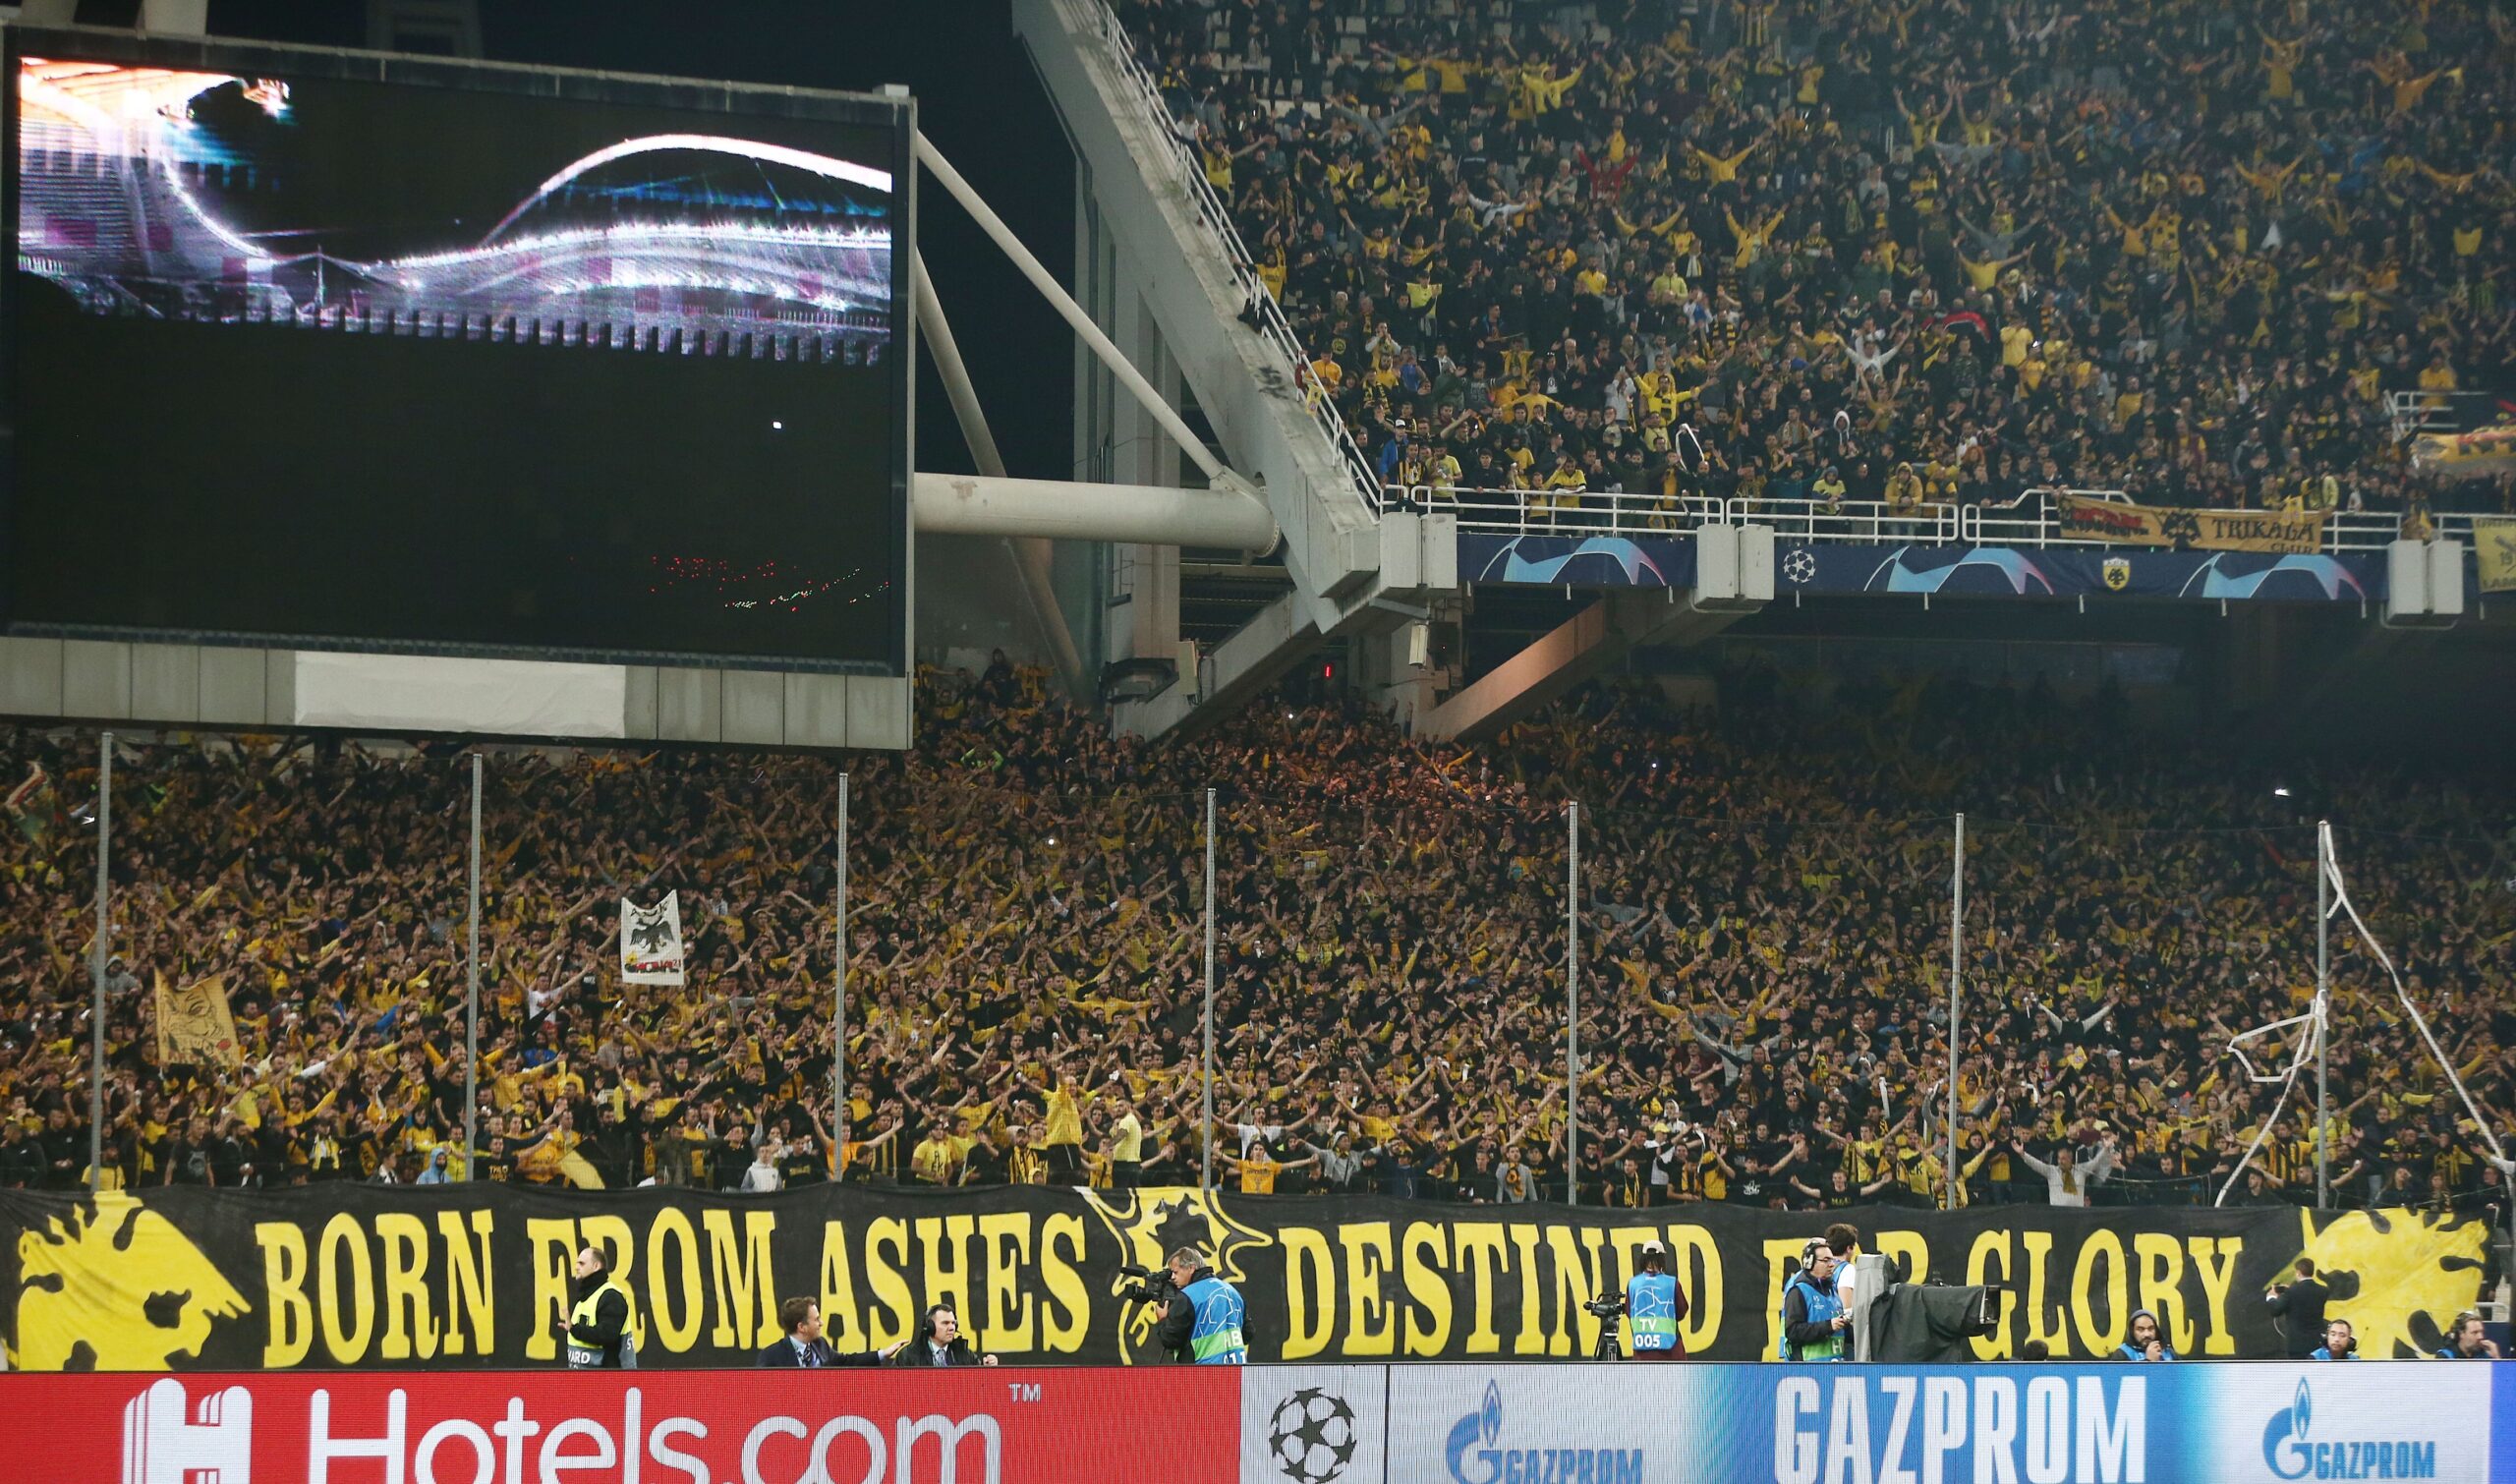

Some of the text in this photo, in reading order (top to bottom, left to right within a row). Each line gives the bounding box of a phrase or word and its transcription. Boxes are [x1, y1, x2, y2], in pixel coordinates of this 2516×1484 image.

[2212, 518, 2315, 542] TRIKALA
[256, 1209, 493, 1368] BORN
[526, 1207, 783, 1360] FROM
[820, 1212, 1089, 1353] ASHES
[1967, 1227, 2244, 1360] GLORY
[1634, 1334, 1661, 1348] 005
[1639, 1318, 1657, 1332] TV
[309, 1387, 1001, 1484] Hotelscom
[1774, 1376, 2146, 1484] GAZPROM
[1506, 1449, 1643, 1484] GAZPROM
[2316, 1441, 2435, 1480] GAZPROM
